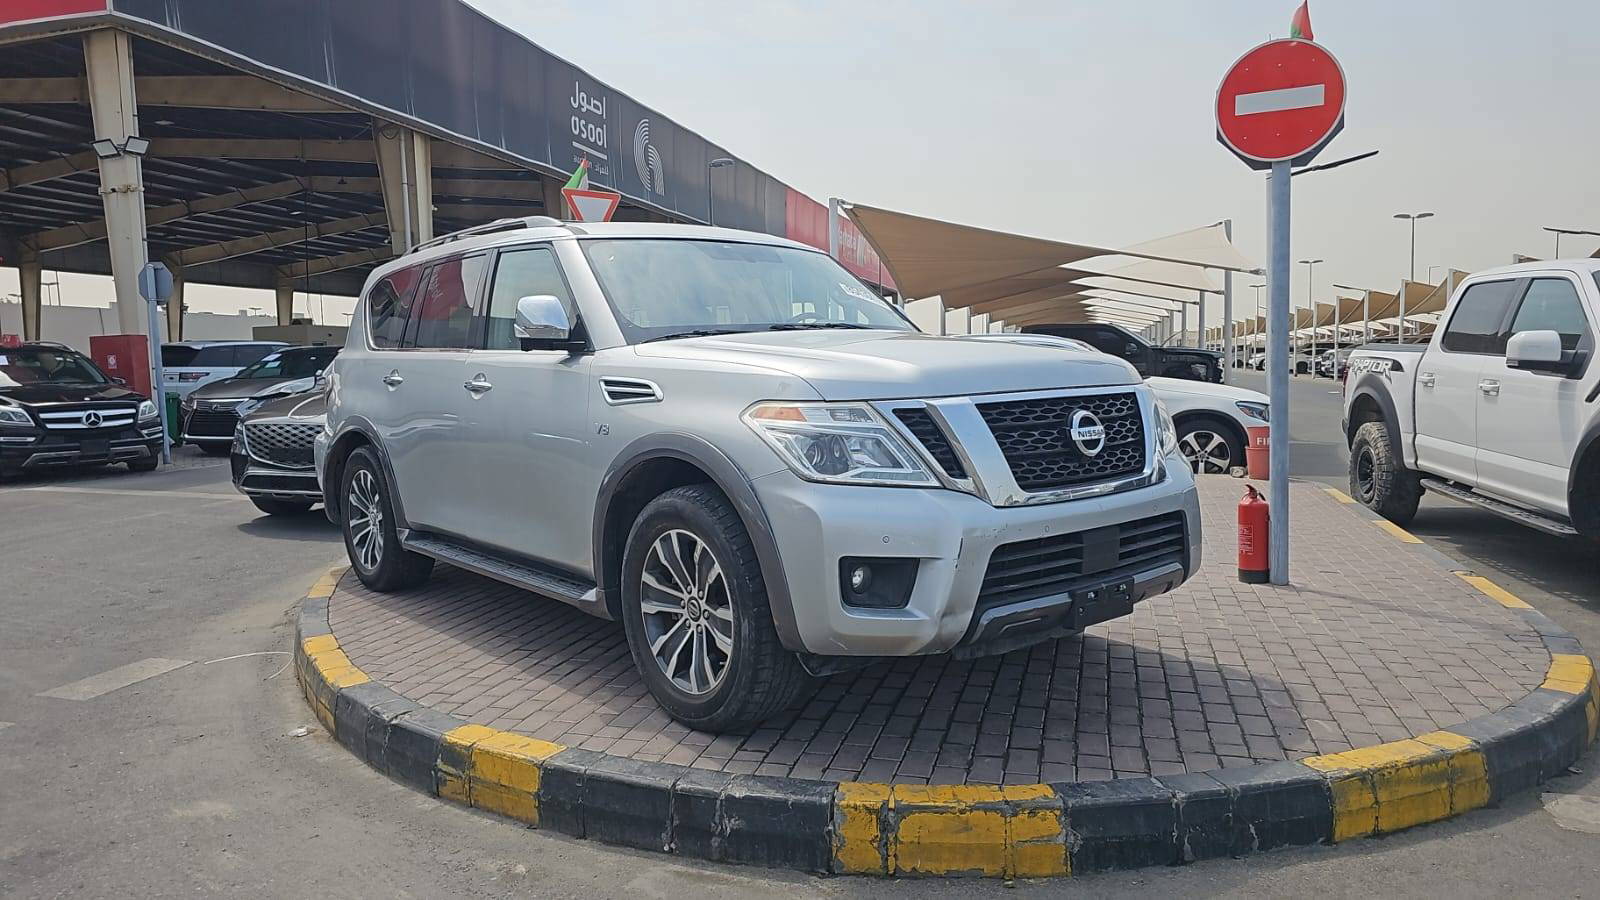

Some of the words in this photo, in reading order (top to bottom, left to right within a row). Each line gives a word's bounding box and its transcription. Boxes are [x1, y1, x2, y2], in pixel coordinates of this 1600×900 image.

[571, 115, 607, 148] osool
[1350, 359, 1393, 380] RAPTOR
[1077, 428, 1104, 439] NISSAN
[1256, 437, 1270, 446] FI
